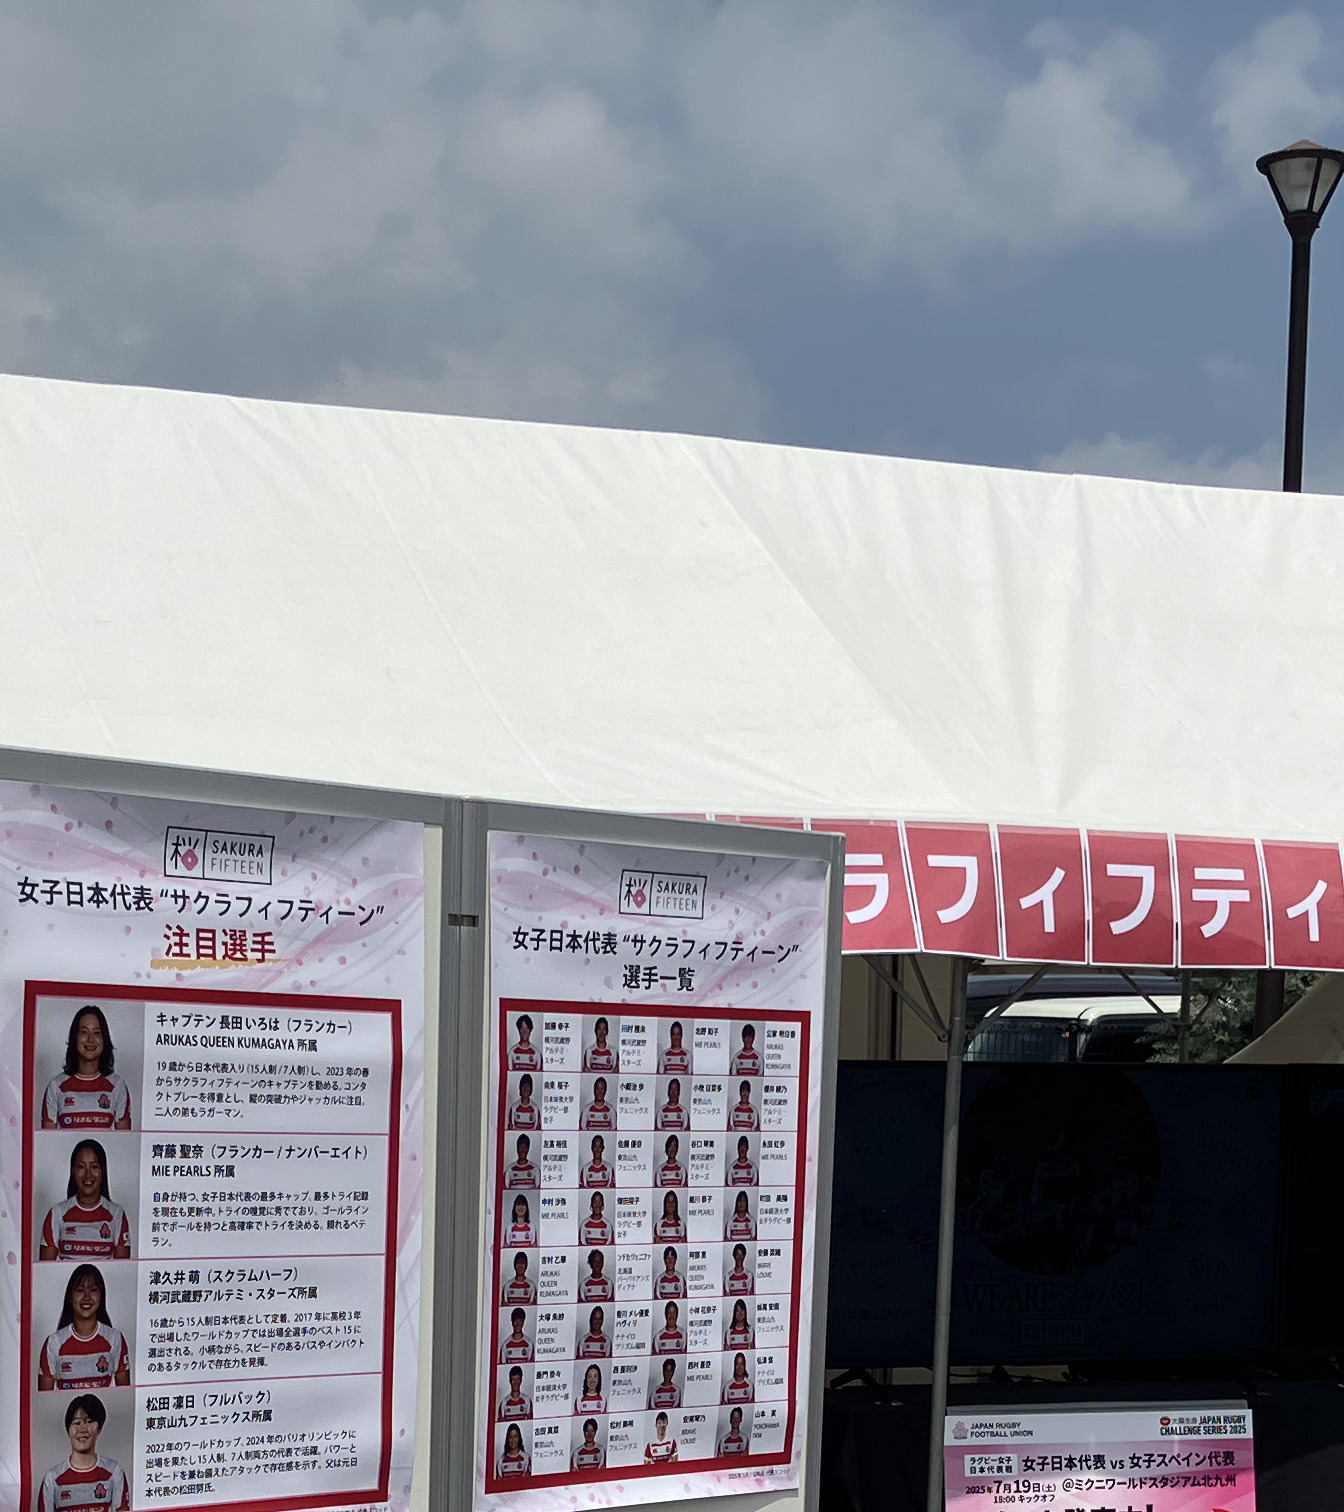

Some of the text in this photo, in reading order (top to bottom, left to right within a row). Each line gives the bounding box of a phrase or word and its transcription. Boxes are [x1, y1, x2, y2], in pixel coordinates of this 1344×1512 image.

[212, 840, 264, 859] SAKURA
[211, 857, 264, 876] FIFTEEN
[657, 881, 698, 895] SAKURA
[656, 896, 697, 911] FIFTEEN
[164, 924, 276, 963] 注目選手
[622, 965, 695, 991] 選手一覧
[156, 1012, 216, 1028] キャプテン
[220, 1015, 242, 1030] 長田
[246, 1017, 279, 1031] いろは
[156, 1034, 318, 1052] ARUKAS QUEEN KUMAGAYA 所属
[152, 1165, 235, 1178] MIE PEARLS 所属
[150, 1271, 185, 1285] 津久井
[189, 1271, 200, 1284] 萌
[146, 1397, 169, 1412] 松田
[146, 1410, 272, 1430] 東京山九フェニックス所属
[1199, 1416, 1221, 1425] JAPAN
[1160, 1425, 1246, 1435] CHALLENGE SERIES 2025
[970, 1456, 1012, 1465] ラグビー女子
[1022, 1451, 1235, 1472] 女子日本代表 vs 女子スペイン代表
[1018, 1494, 1055, 1502] キックオフ
